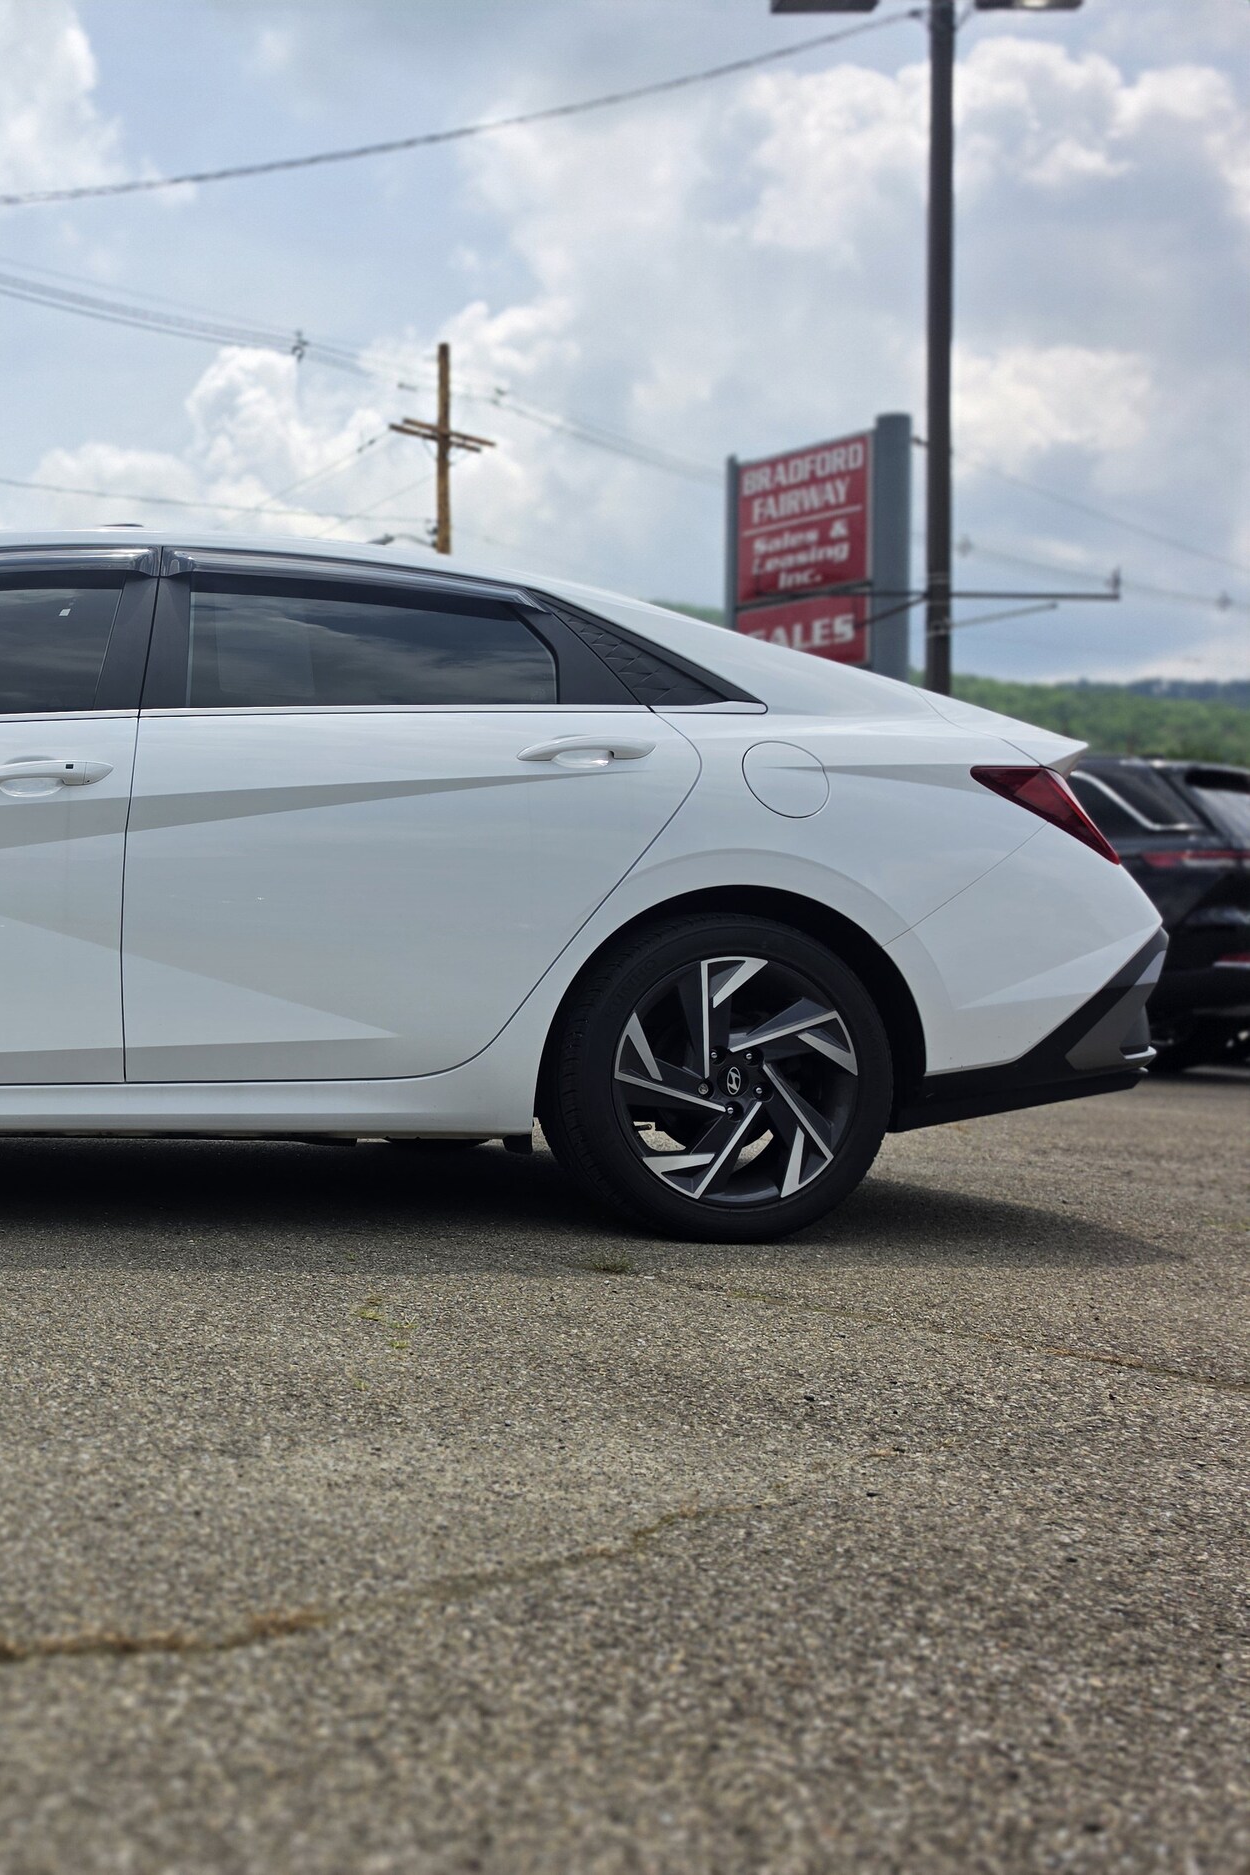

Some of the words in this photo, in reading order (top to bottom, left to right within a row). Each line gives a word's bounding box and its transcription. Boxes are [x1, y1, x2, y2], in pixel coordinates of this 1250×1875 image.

[741, 442, 864, 496] BRADFORD
[752, 476, 851, 525] FAIRWAY
[752, 528, 820, 556] Sales
[829, 519, 848, 539] &
[752, 541, 850, 576] Leasing
[778, 568, 822, 590] Inc.
